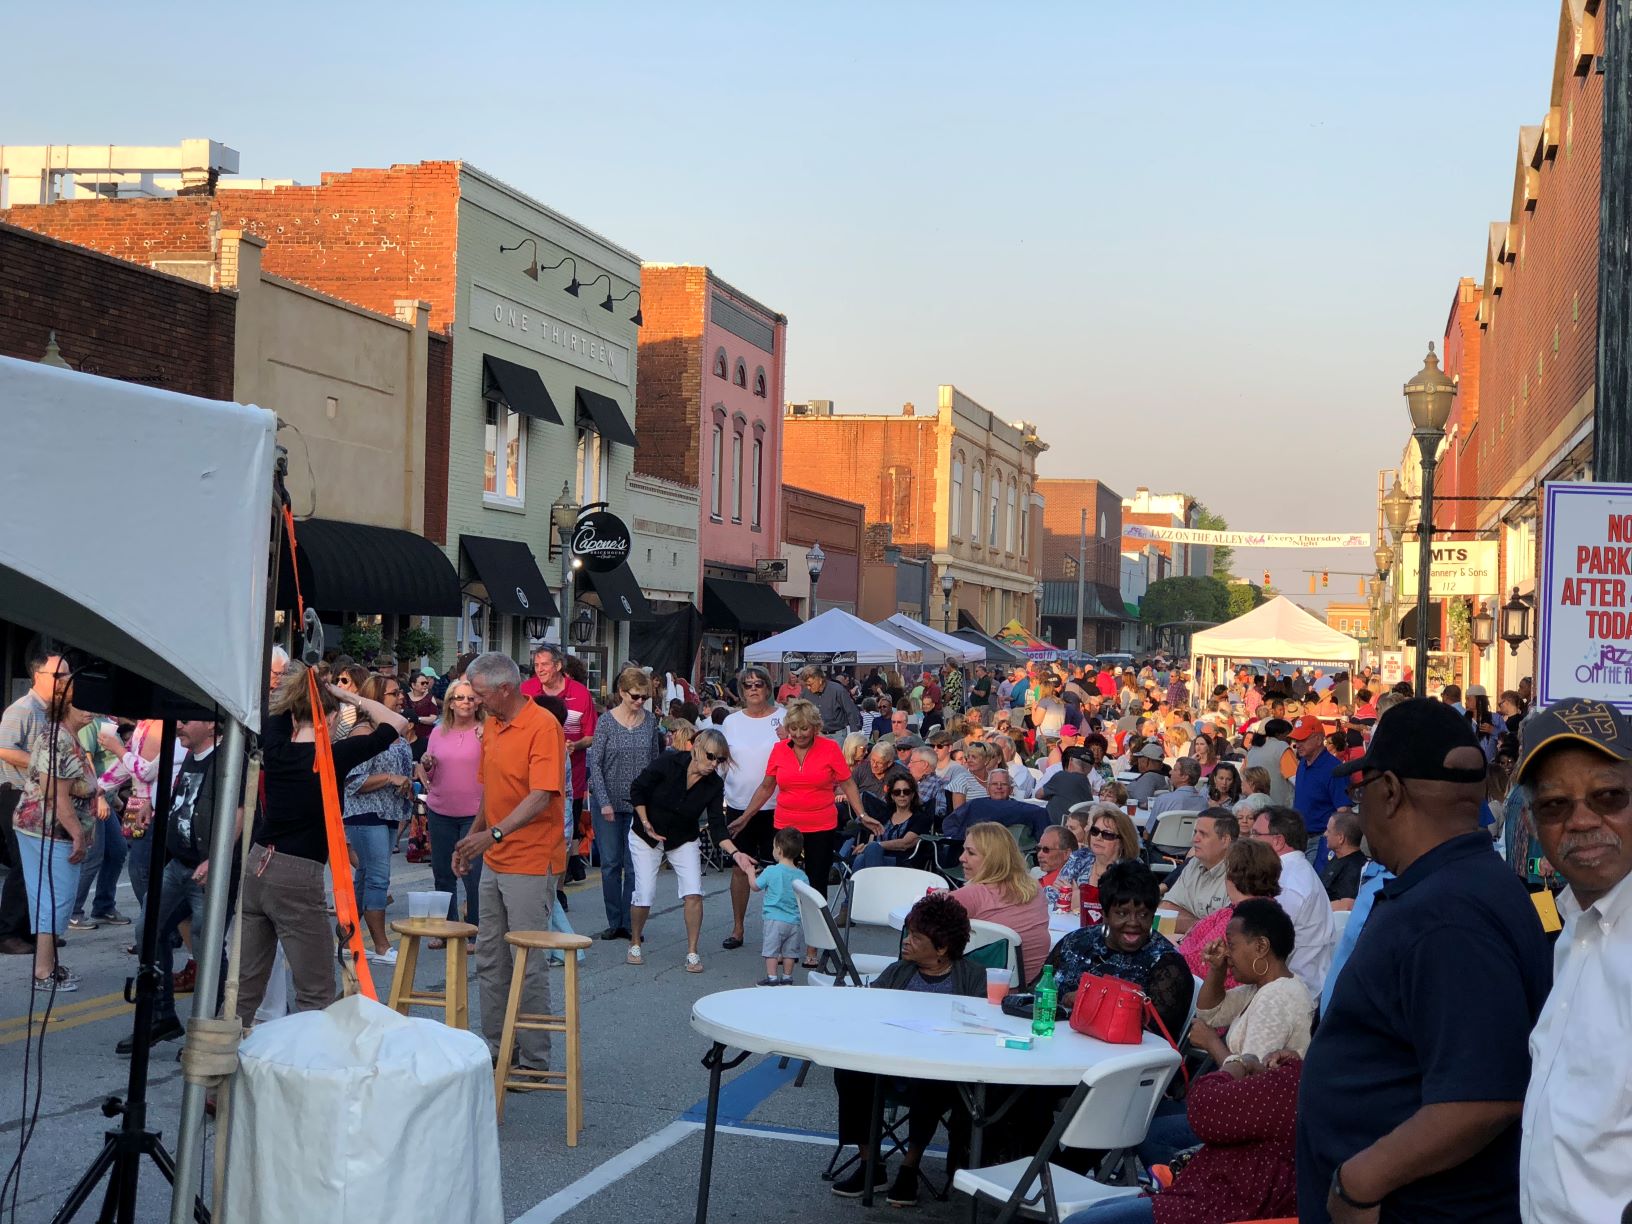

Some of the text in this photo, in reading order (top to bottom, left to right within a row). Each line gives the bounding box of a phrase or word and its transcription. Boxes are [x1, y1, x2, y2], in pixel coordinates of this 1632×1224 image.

[494, 304, 615, 367] ONE THIRTEEN
[1149, 529, 1173, 539] JAZZ
[1175, 531, 1188, 540] ON
[1192, 532, 1211, 542] THE
[1211, 534, 1243, 545] ALLEY
[1608, 514, 1632, 543] NO
[573, 528, 627, 554] Capone's
[1430, 548, 1468, 561] MTS
[1460, 568, 1466, 577] &
[1468, 567, 1488, 577] Sons
[1442, 582, 1456, 591] 112
[1561, 577, 1626, 607] AFTER
[1602, 665, 1623, 684] THE
